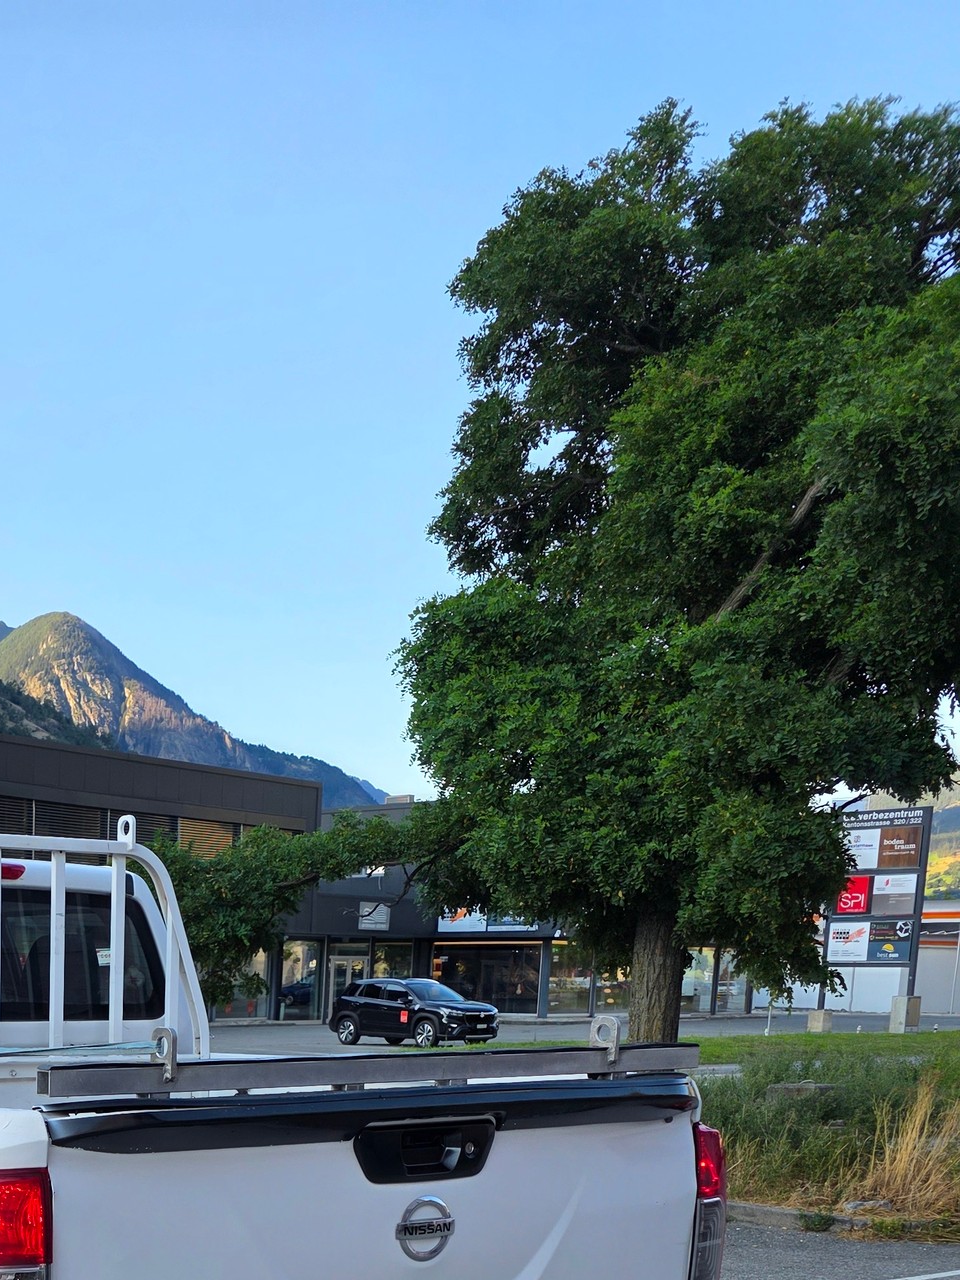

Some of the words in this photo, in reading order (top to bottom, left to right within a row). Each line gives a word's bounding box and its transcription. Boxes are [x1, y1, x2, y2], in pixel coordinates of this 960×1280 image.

[843, 820, 890, 828] Kantonsstrasse
[840, 893, 865, 908] SPI
[403, 1222, 451, 1236] NISSAN
